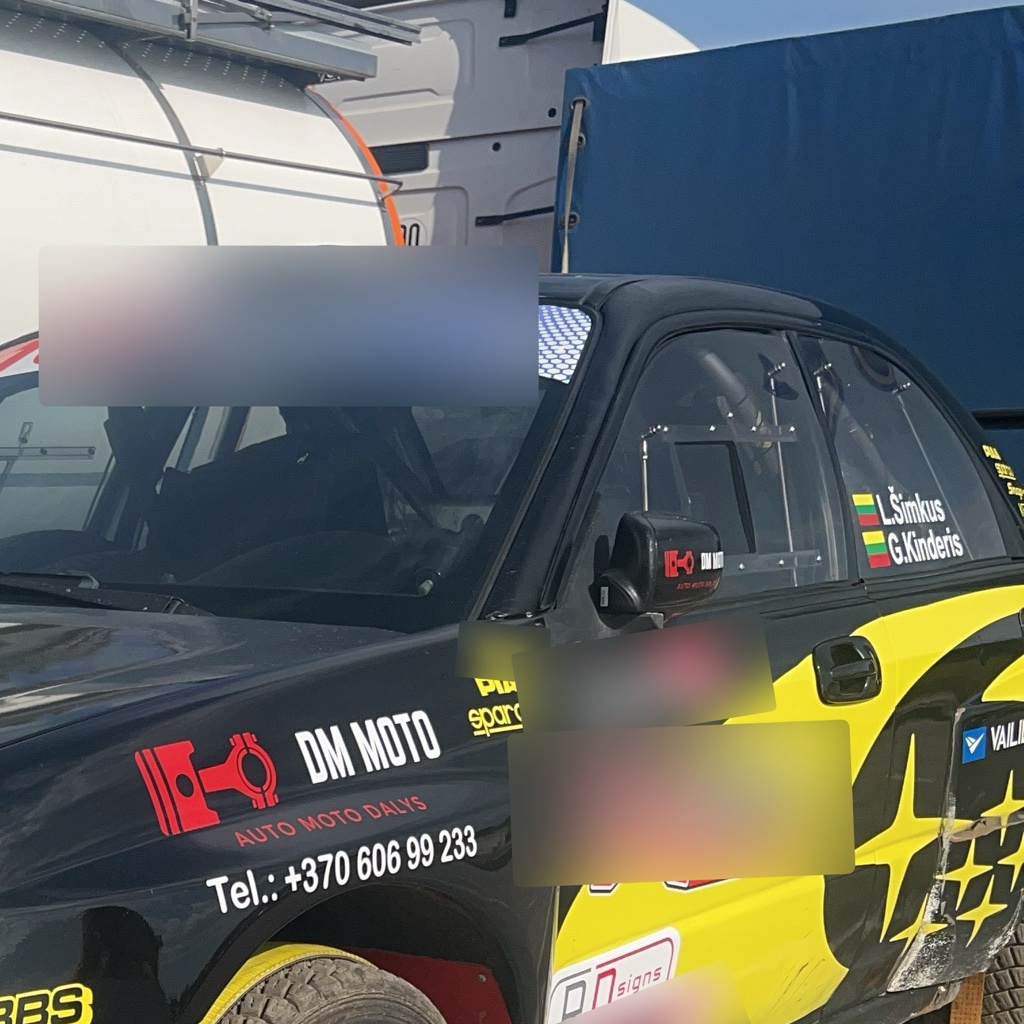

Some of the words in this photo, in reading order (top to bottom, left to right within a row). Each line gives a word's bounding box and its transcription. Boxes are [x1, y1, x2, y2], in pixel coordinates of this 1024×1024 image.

[876, 486, 946, 526] L.Šimkus
[887, 527, 964, 566] G.Kinderis
[294, 725, 356, 784] DM
[349, 709, 442, 773] MOTO
[990, 719, 1024, 751] VAILI
[233, 821, 297, 847] AUTO
[297, 808, 363, 833] MOTO
[362, 795, 428, 820] DALYS
[205, 869, 279, 914] Tel.:
[284, 850, 351, 893] +370
[356, 839, 401, 881] 606
[406, 833, 435, 870] 99
[439, 824, 478, 864] 233
[616, 966, 663, 998] signs
